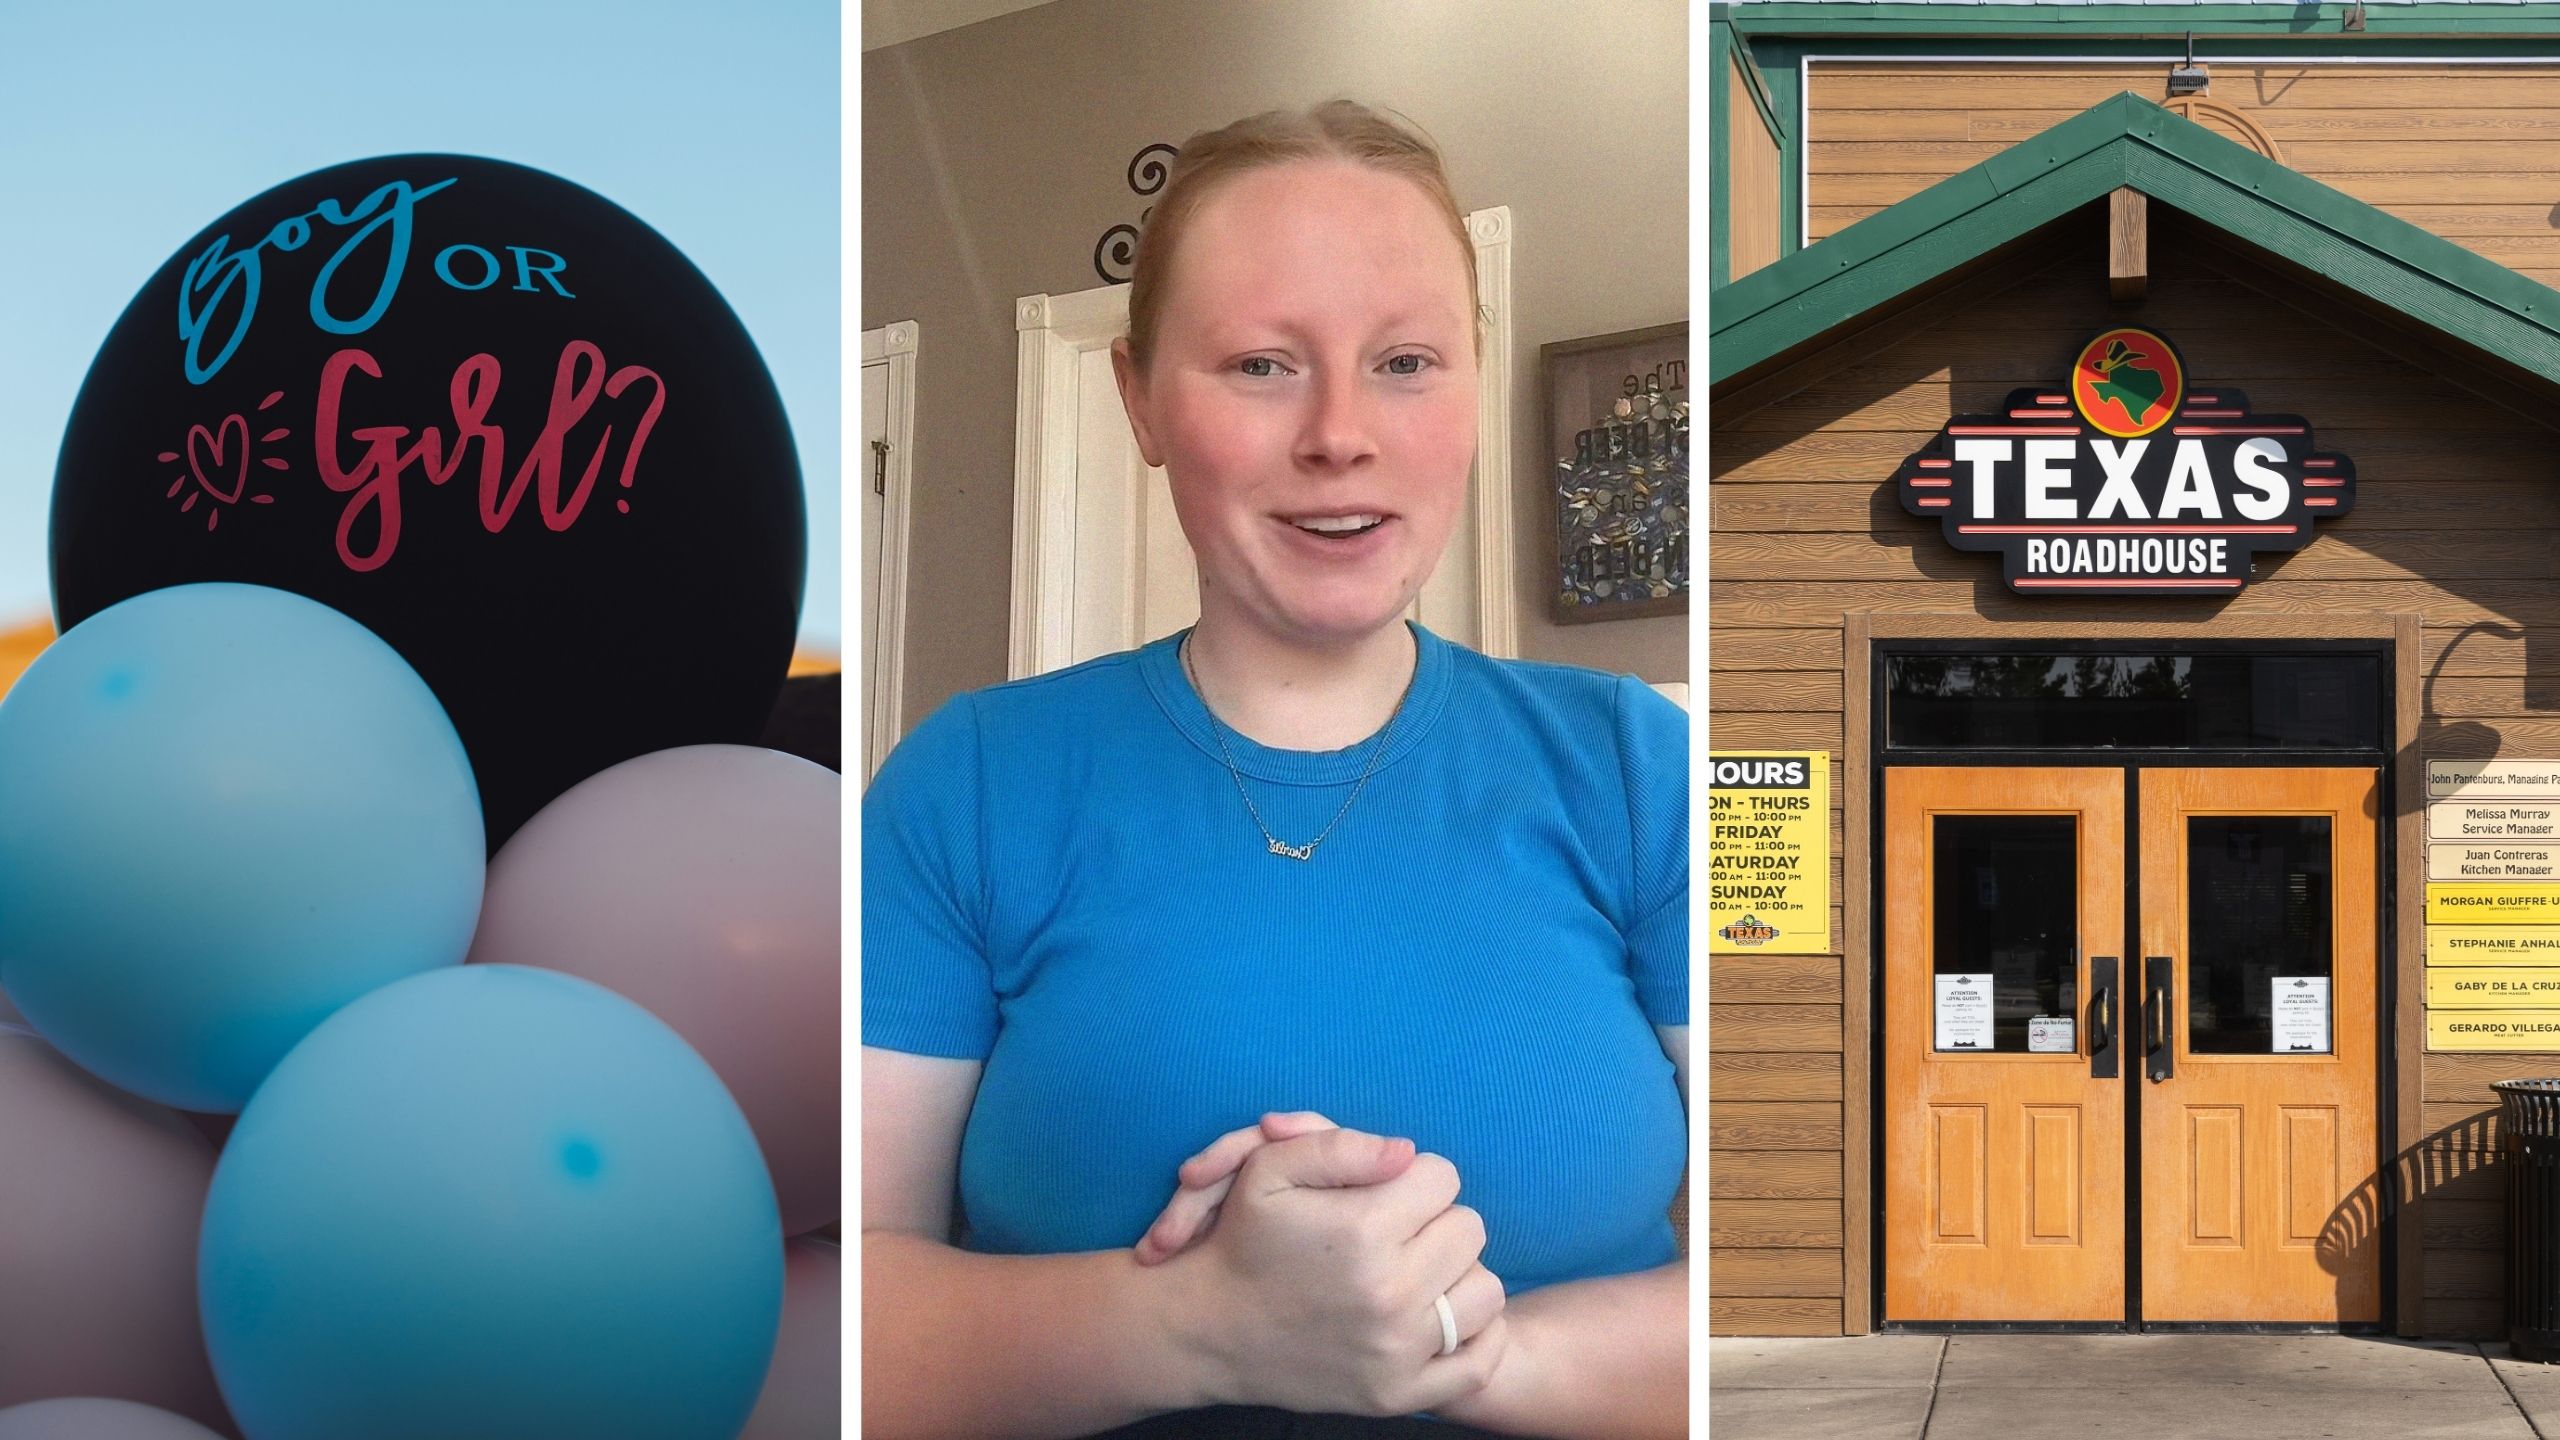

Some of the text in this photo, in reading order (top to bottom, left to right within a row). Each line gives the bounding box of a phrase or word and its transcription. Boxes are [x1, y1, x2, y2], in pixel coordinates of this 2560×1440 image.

[434, 244, 576, 299] OR
[178, 178, 459, 385] Boy
[315, 340, 666, 573] Girl?
[1954, 437, 2291, 521] TEXAS
[2027, 538, 2227, 574] ROADHOUSE
[2431, 774, 2451, 784] John
[2507, 774, 2549, 784] Managing
[1749, 796, 1810, 810] THURS
[1753, 812, 1787, 821] 10:00
[2466, 809, 2550, 819] Melissa Murray
[1715, 825, 1783, 839] FRIDAY
[2462, 824, 2553, 834] Service Manager
[1754, 841, 1785, 850] 11:00
[2465, 850, 2548, 860] Juan Contreras
[1709, 856, 1800, 869] ATURDAY
[2461, 864, 2553, 875] Kitchen Manager
[1755, 872, 1786, 881] 11:00
[1711, 885, 1787, 899] SUNDAY
[1754, 901, 1788, 910] 10:00
[2440, 897, 2493, 906] MORGAN
[1728, 927, 1771, 939] TEXAS
[2450, 939, 2516, 948] STEPHANIE
[2455, 982, 2487, 991] GABY
[2492, 982, 2508, 991] DE
[2512, 982, 2528, 991] LA
[2449, 1024, 2507, 1033] GERARDO
